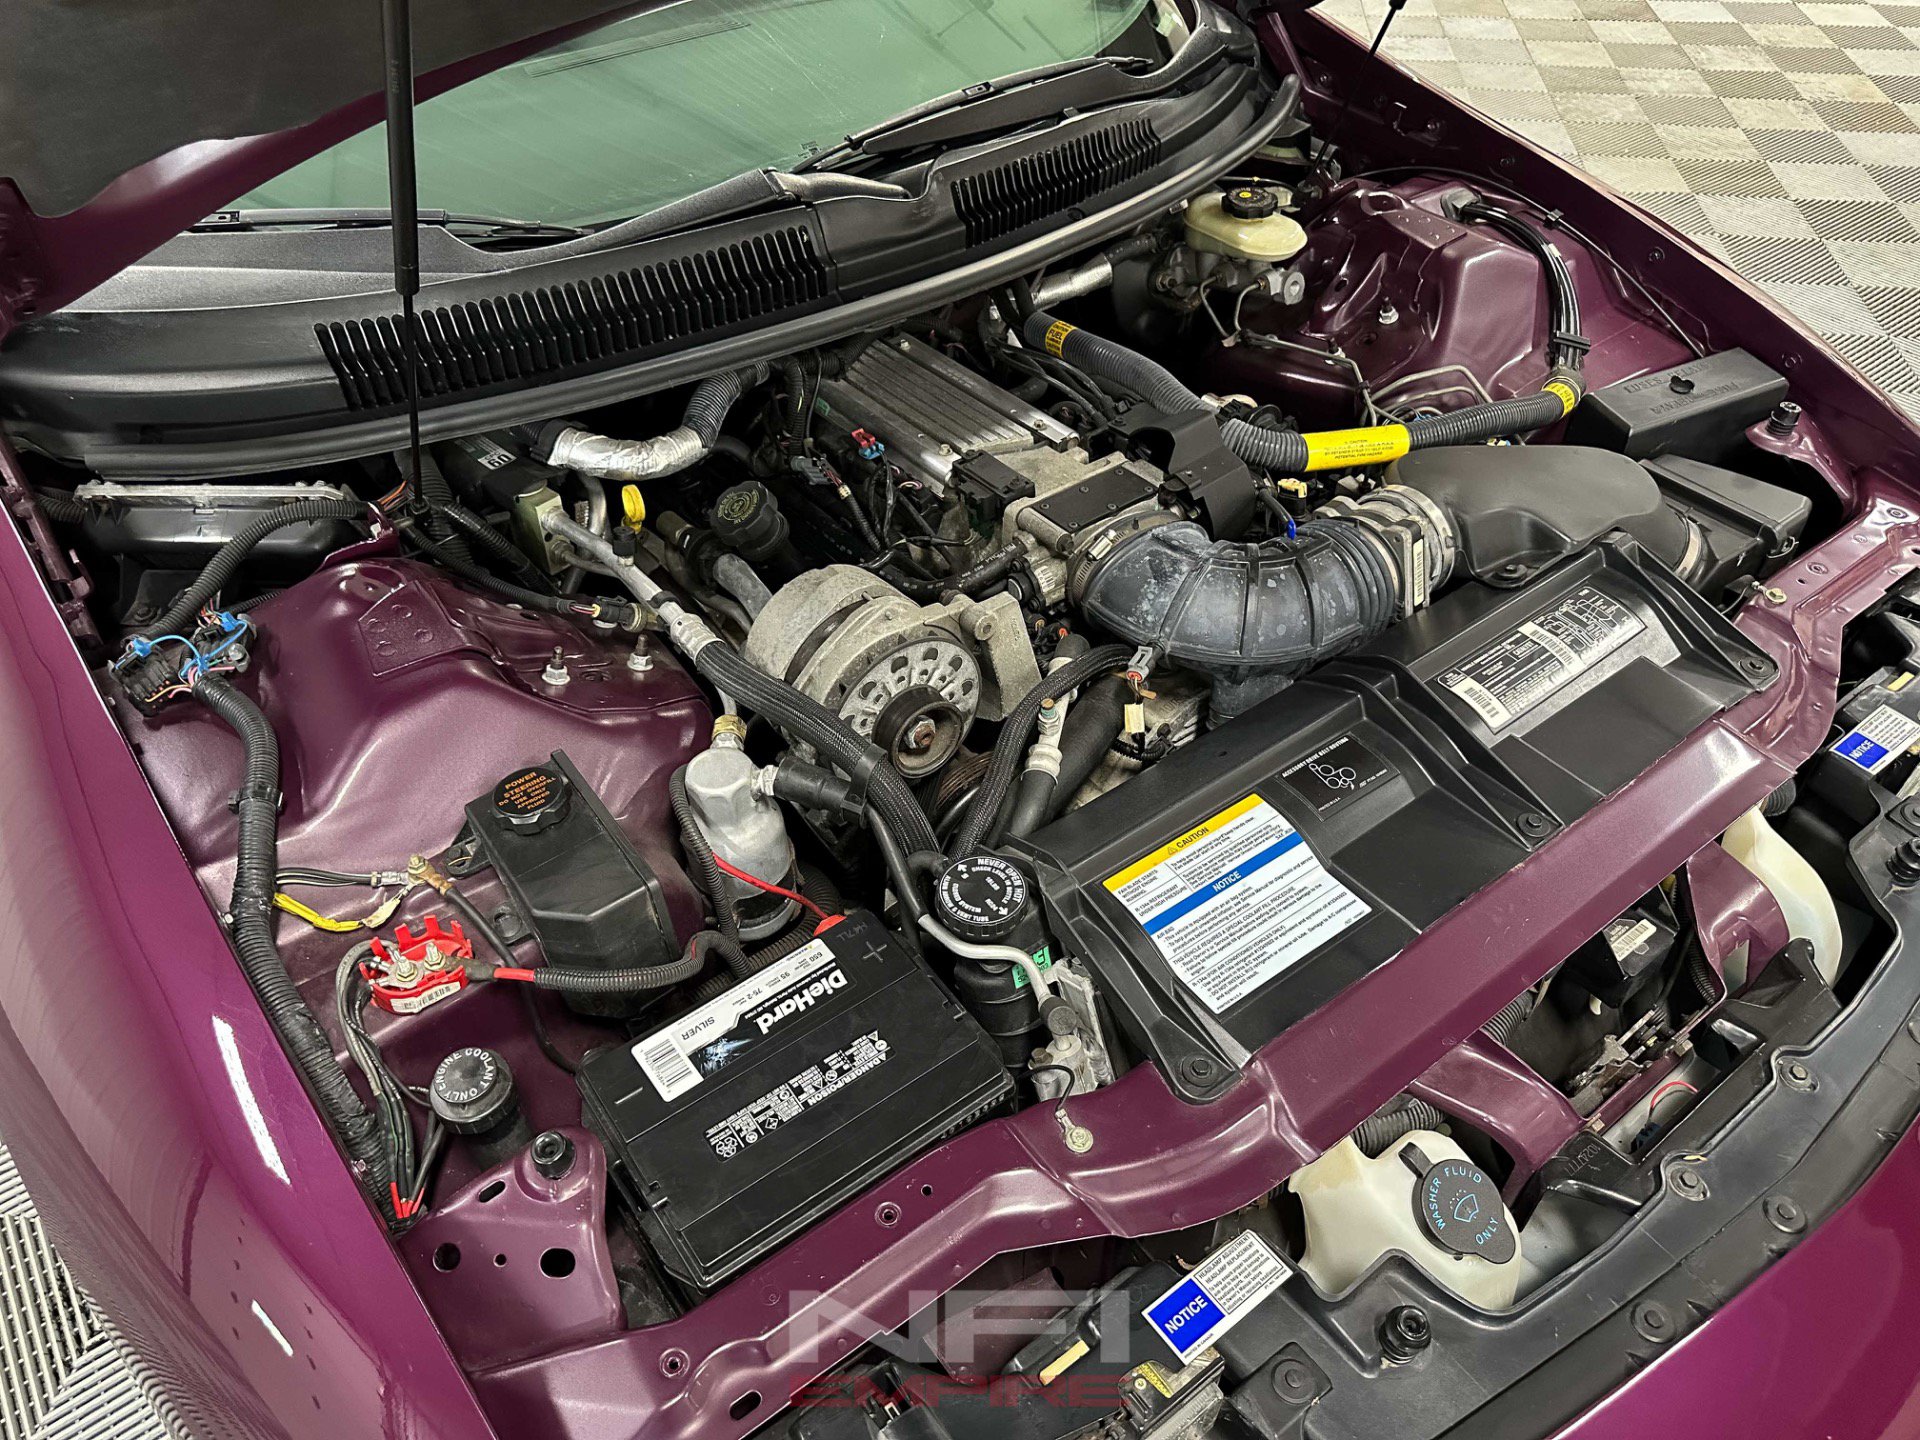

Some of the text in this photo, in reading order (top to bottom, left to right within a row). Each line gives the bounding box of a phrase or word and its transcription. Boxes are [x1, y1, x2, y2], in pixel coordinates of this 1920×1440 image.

[1848, 739, 1874, 759] NOTICE
[498, 776, 556, 806] DO NOT OVERFILL
[503, 775, 546, 798] STEERING
[504, 771, 536, 789] POWER
[513, 787, 546, 804] USE ONLY
[516, 790, 550, 808] APPROVED
[527, 798, 545, 809] FLUID
[1175, 826, 1209, 848] CAUTION
[977, 858, 1023, 903] NEVER OPEN HOT
[1211, 870, 1241, 891] NOTICE
[956, 909, 972, 919] VENT
[808, 951, 822, 962] 650
[779, 970, 790, 979] 95
[680, 1015, 716, 1040] SILVER
[435, 1048, 494, 1100] ENGINE COOLANT ONLY
[806, 1056, 881, 1105] DANGER/POISON
[1428, 1166, 1482, 1230] WASHER FLUID
[1475, 1217, 1498, 1245] ONLY
[1197, 1234, 1250, 1278] HEADLAMP ADJUSTMENT
[1204, 1241, 1255, 1283] HEADLAMP REPLACEMENT
[1164, 1295, 1209, 1333] NOTICE
